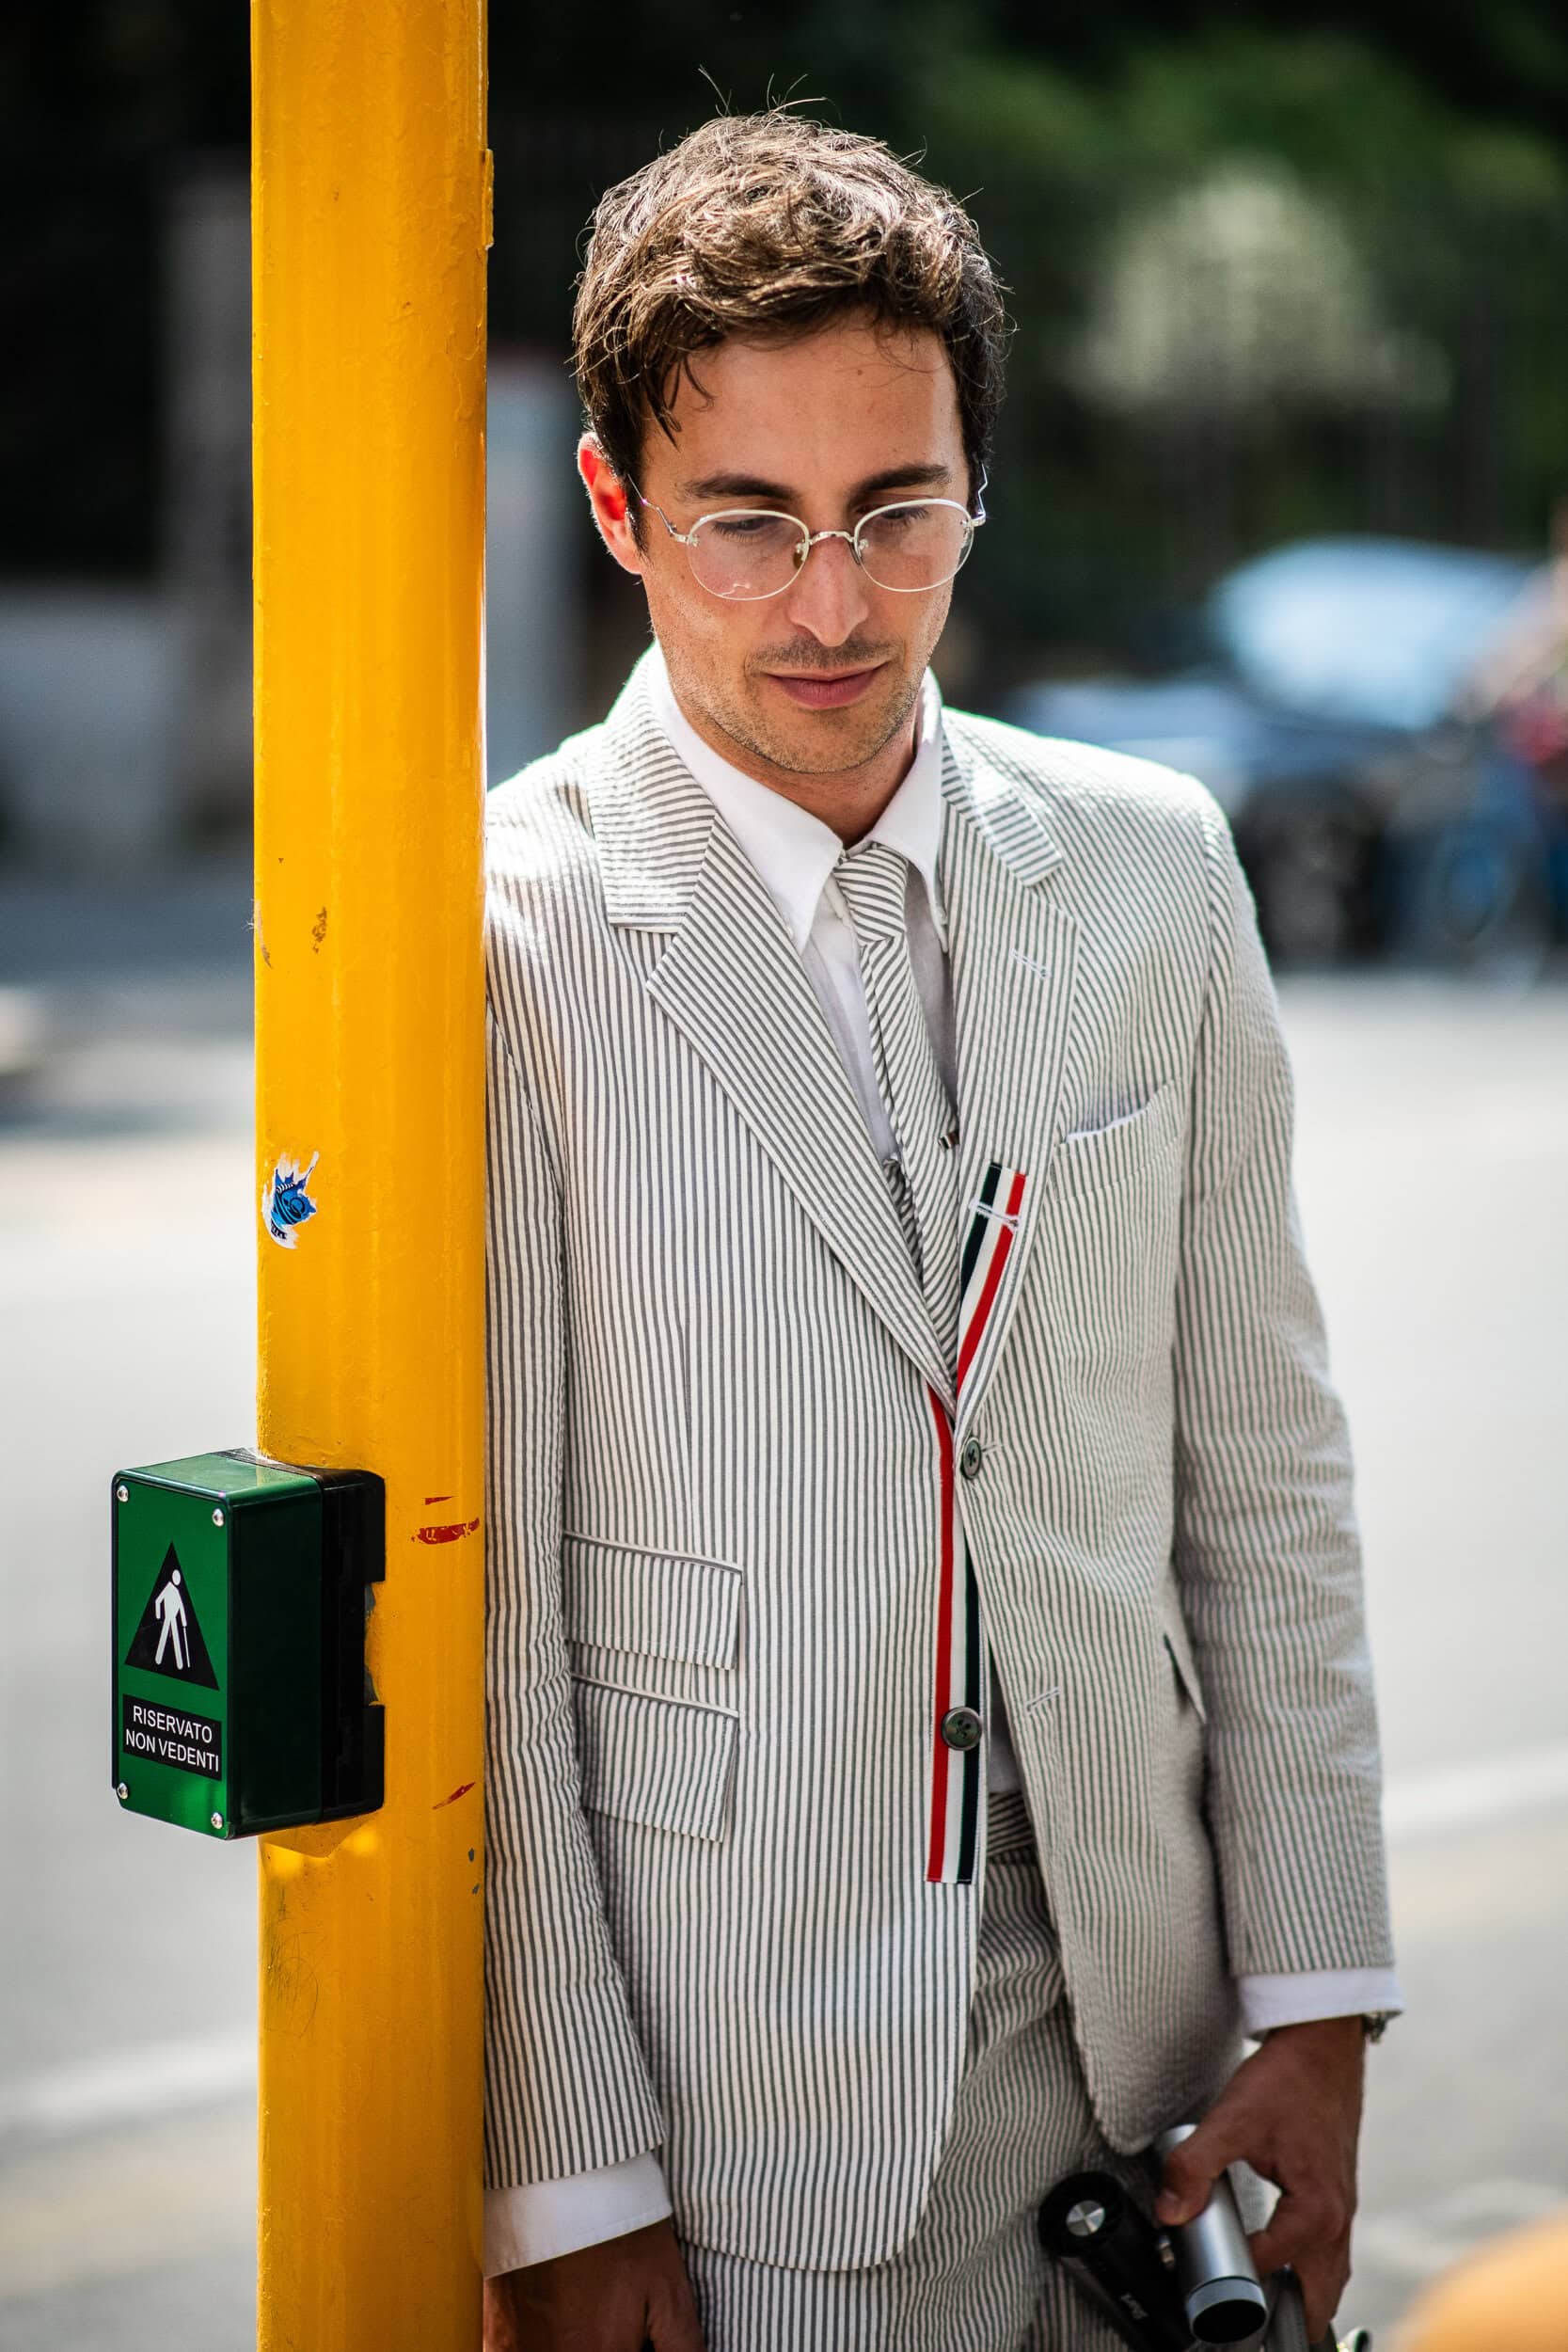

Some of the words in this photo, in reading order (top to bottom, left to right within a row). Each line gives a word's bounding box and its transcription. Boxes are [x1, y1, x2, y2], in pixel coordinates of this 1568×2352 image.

[133, 1705, 213, 1743] RISERVATO
[125, 1728, 156, 1754] NON
[158, 1738, 219, 1772] VEDENTI
